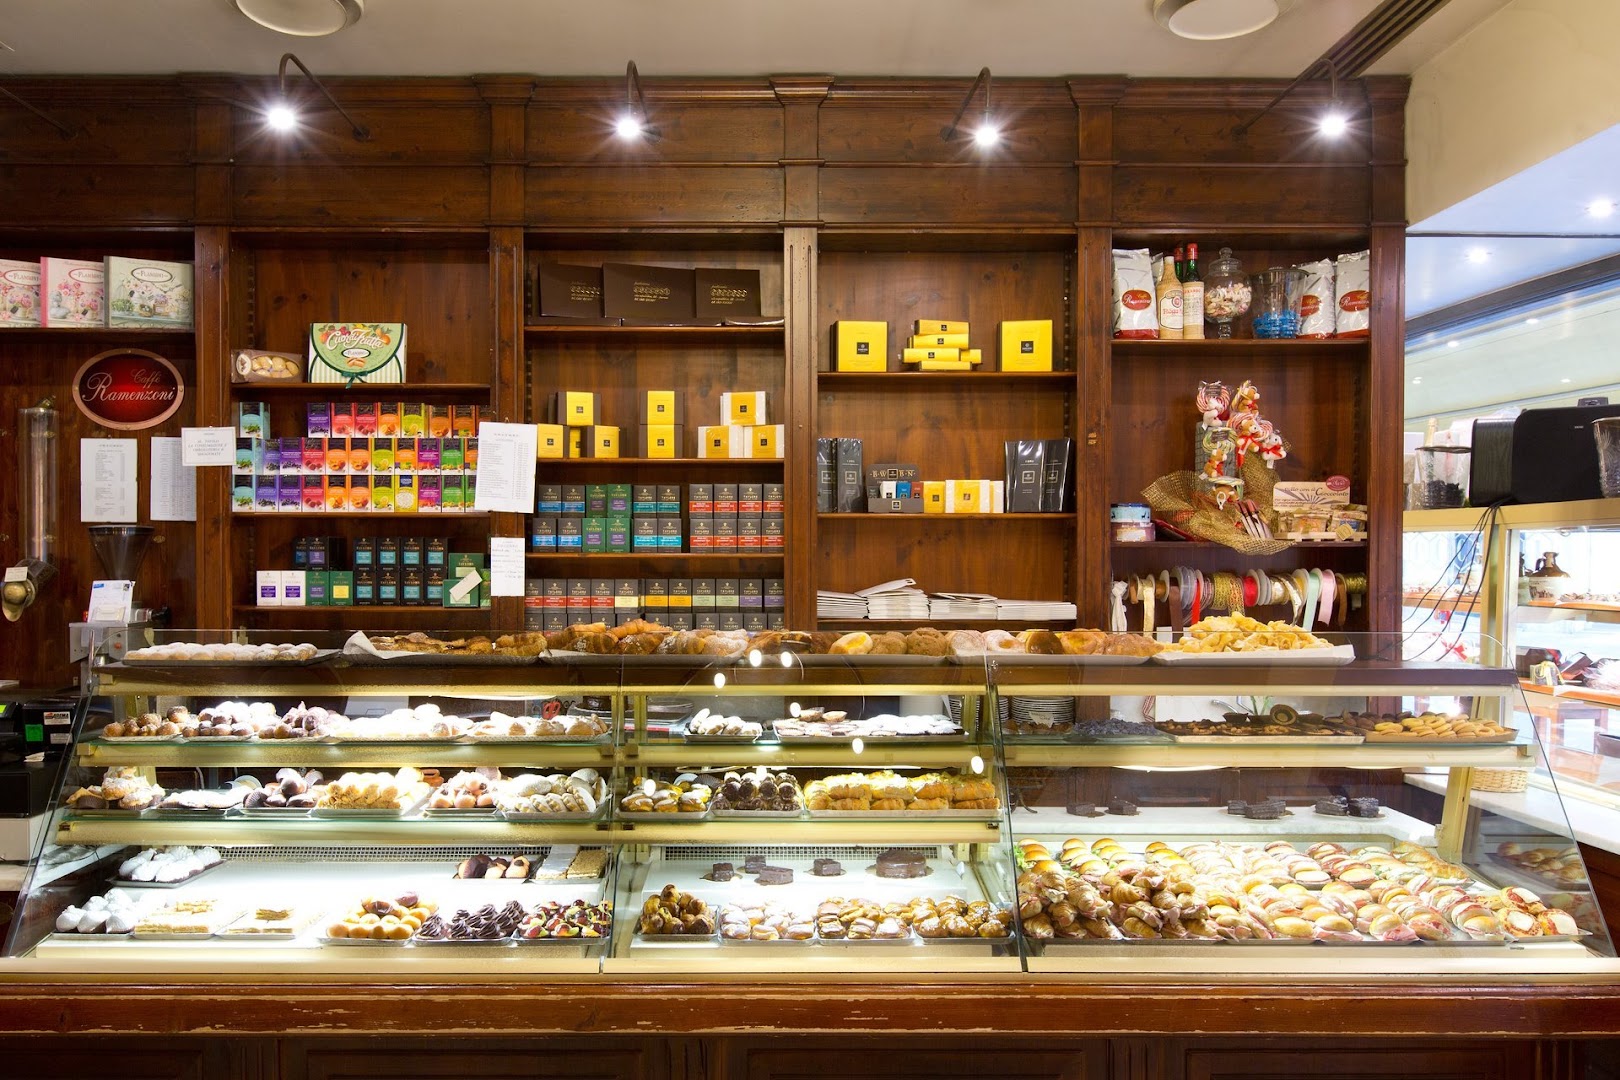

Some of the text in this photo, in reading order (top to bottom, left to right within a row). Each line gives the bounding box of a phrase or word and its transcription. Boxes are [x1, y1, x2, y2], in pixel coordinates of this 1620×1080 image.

[326, 330, 350, 350] Cuor
[82, 372, 176, 402] Ramenzoni
[130, 368, 161, 388] Caffè
